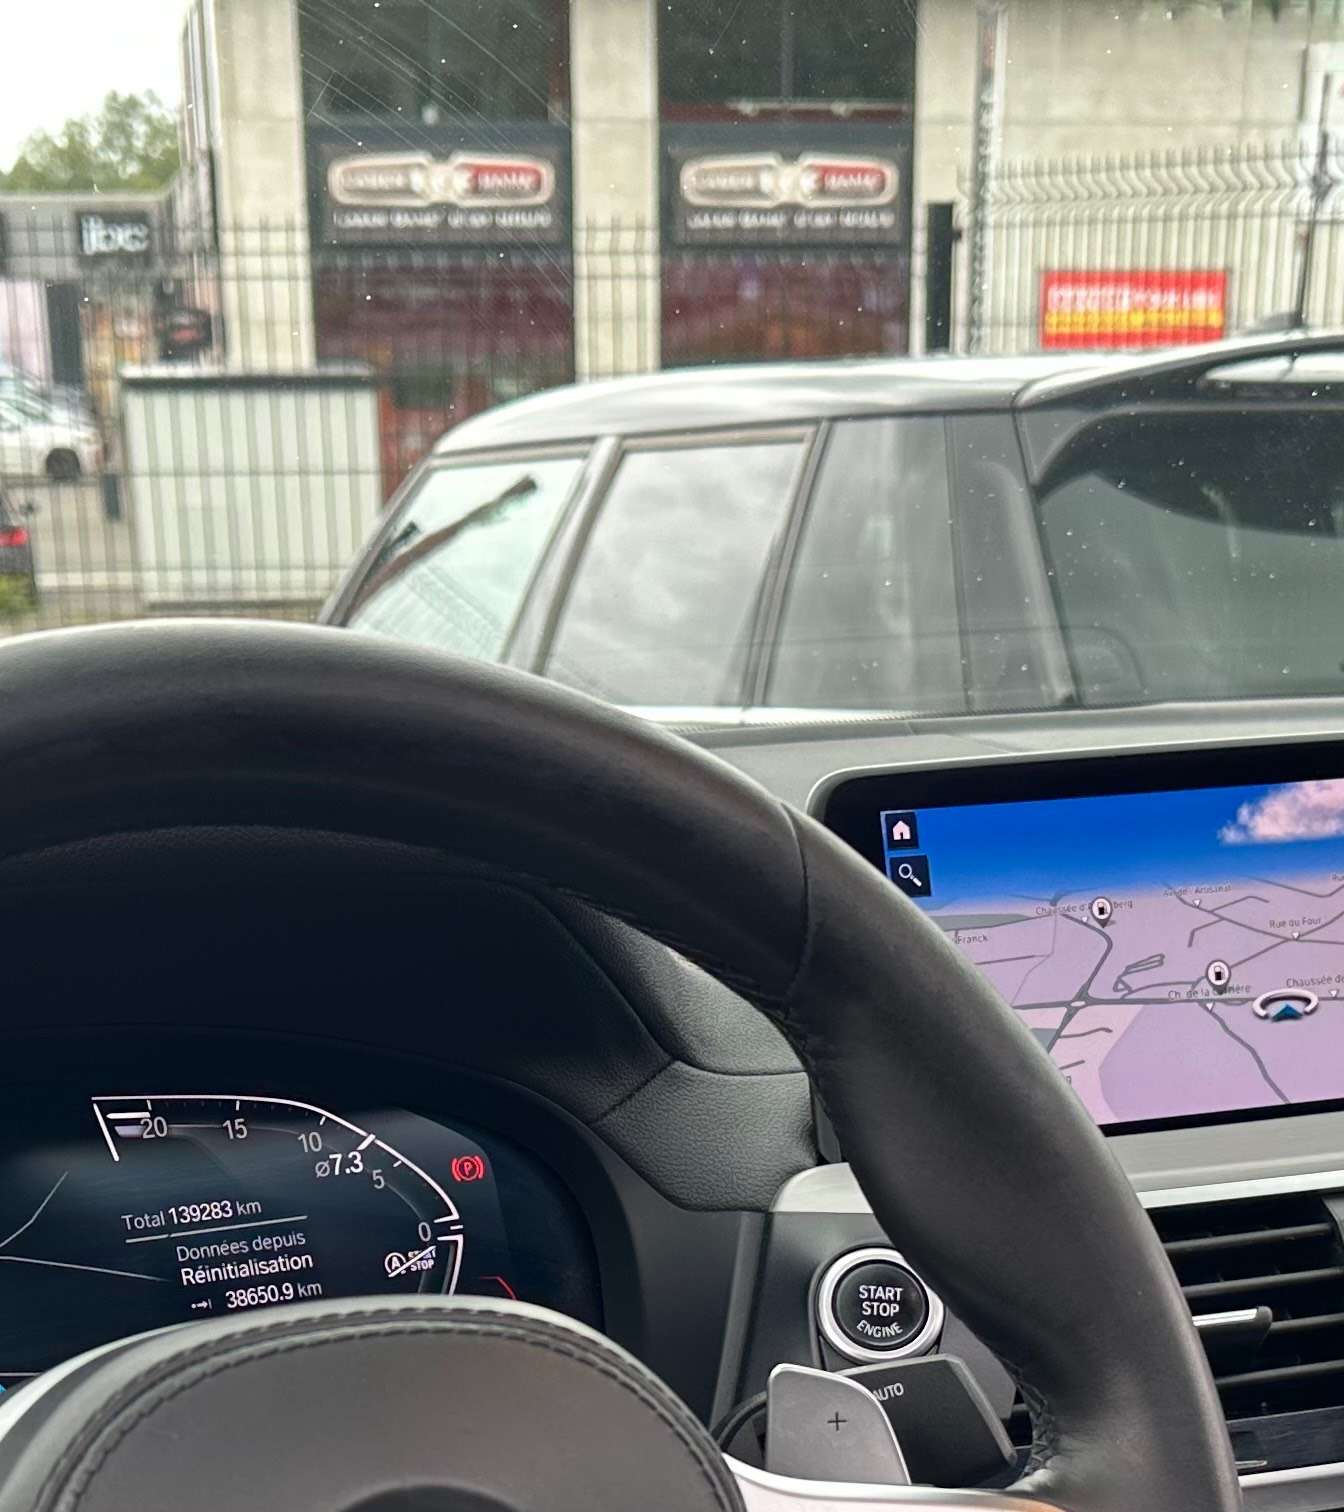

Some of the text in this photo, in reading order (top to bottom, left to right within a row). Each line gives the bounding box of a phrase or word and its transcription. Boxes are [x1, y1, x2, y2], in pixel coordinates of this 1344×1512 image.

[1269, 919, 1290, 930] Rue
[1303, 915, 1323, 926] Four
[1285, 973, 1336, 988] Chaussée
[140, 1117, 432, 1242] 20 15 10 5 0
[121, 1200, 263, 1231] Total 139283 km
[176, 1231, 306, 1263] Données depuis
[181, 1252, 314, 1287] Réinitialisation
[410, 1258, 435, 1272] STOP
[225, 1280, 323, 1309] 38650.9 km
[859, 1284, 903, 1301] START
[862, 1301, 900, 1317] STOP
[856, 1319, 904, 1338] ENGINE
[872, 1382, 904, 1401] AUTO
